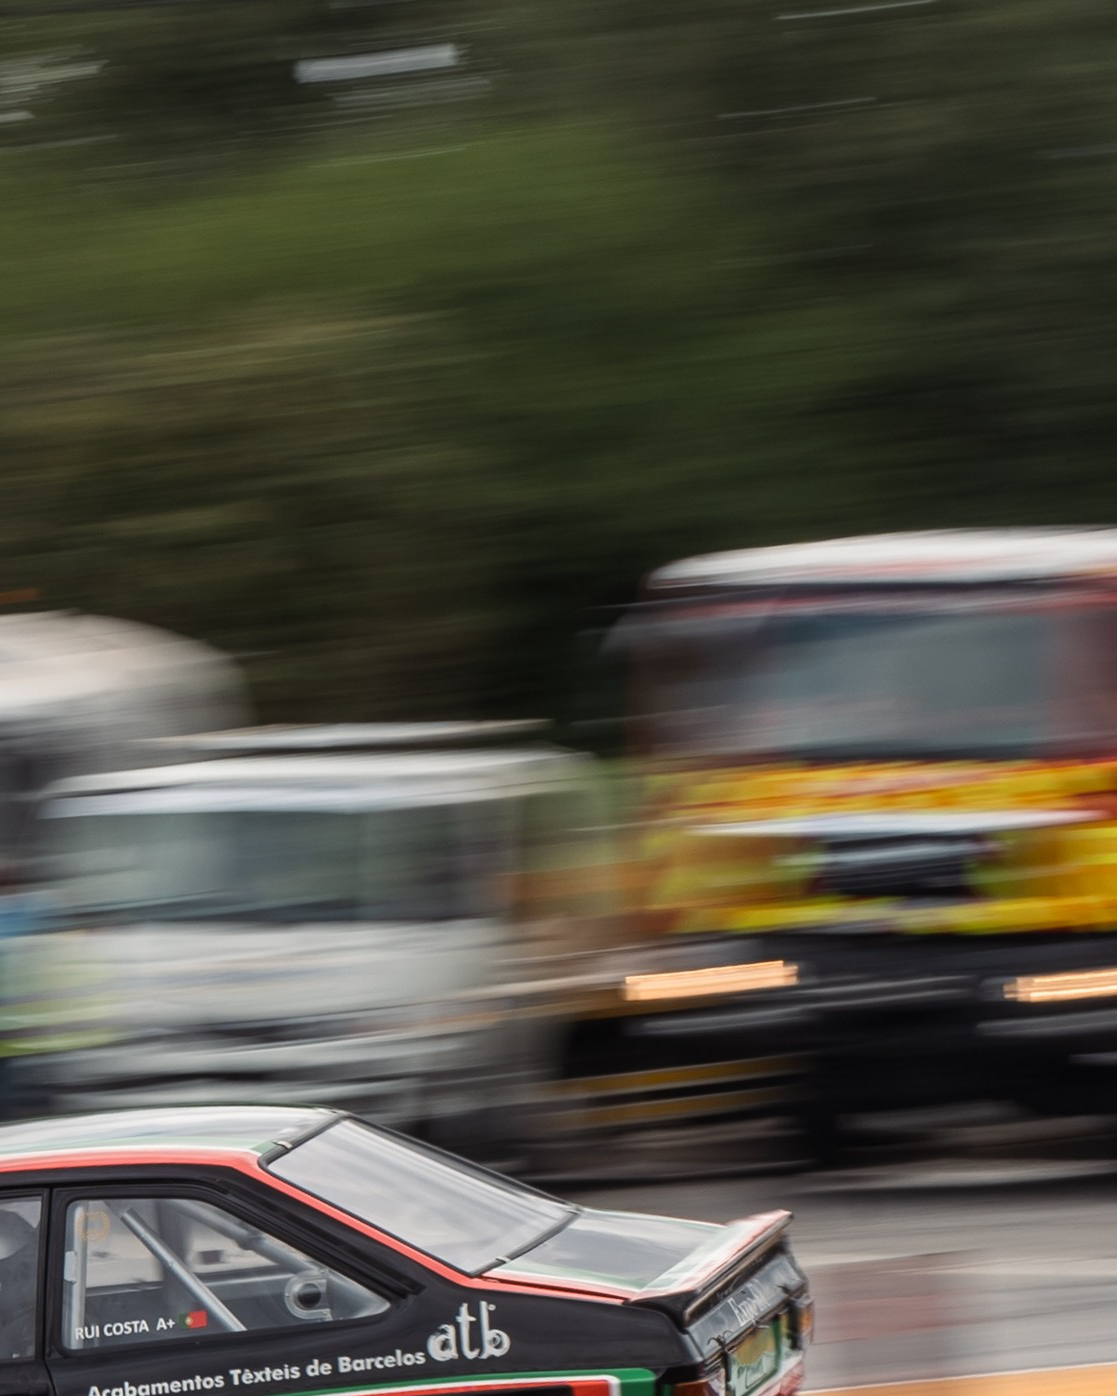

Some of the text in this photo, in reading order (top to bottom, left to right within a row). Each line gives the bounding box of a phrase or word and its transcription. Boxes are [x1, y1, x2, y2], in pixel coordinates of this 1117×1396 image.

[75, 1317, 175, 1340] RUI COSTA A+
[427, 1301, 511, 1361] atb
[306, 1359, 332, 1377] de
[337, 1349, 426, 1373] Barcelos
